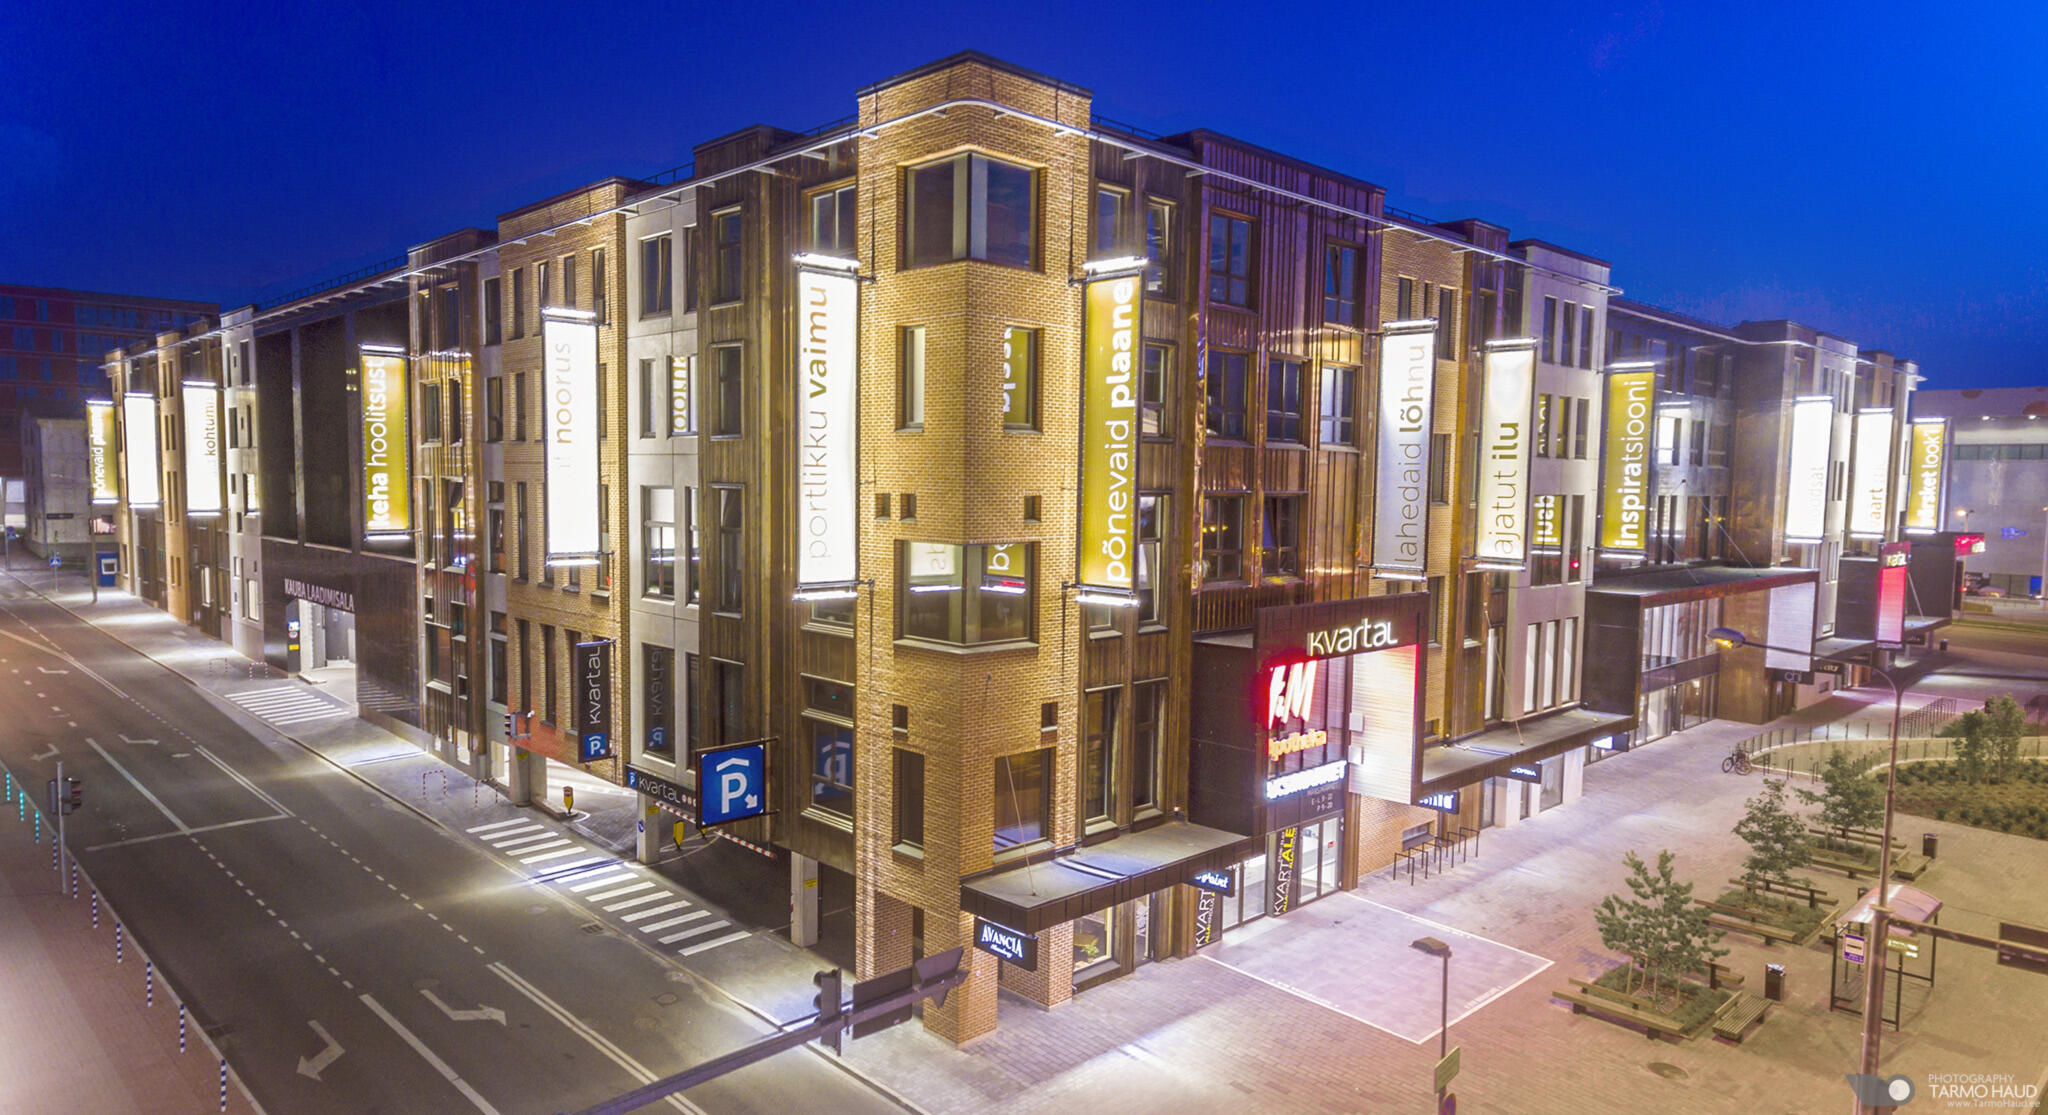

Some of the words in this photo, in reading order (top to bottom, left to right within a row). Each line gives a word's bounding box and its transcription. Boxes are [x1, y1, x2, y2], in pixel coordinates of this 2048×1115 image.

[803, 286, 828, 398] vaimu
[1106, 281, 1136, 410] plaane
[365, 358, 387, 467] hoolitsust
[1399, 345, 1425, 432] lõhnu
[1492, 421, 1519, 461] ilu
[1615, 380, 1647, 547] inspiratsiooni
[367, 472, 390, 530] keha
[1102, 419, 1132, 582] põnevaid
[1394, 442, 1422, 563] lahedaid
[1489, 468, 1520, 555] ajatut
[284, 578, 306, 599] KAUBA
[307, 583, 355, 612] LAADIMISALA
[1306, 618, 1398, 656] kvartal
[586, 646, 601, 724] kvartal
[639, 776, 681, 804] kvartal
[1273, 826, 1297, 915] KVARTALE
[981, 924, 1023, 959] AVANCIA
[1196, 888, 1212, 947] KVART
